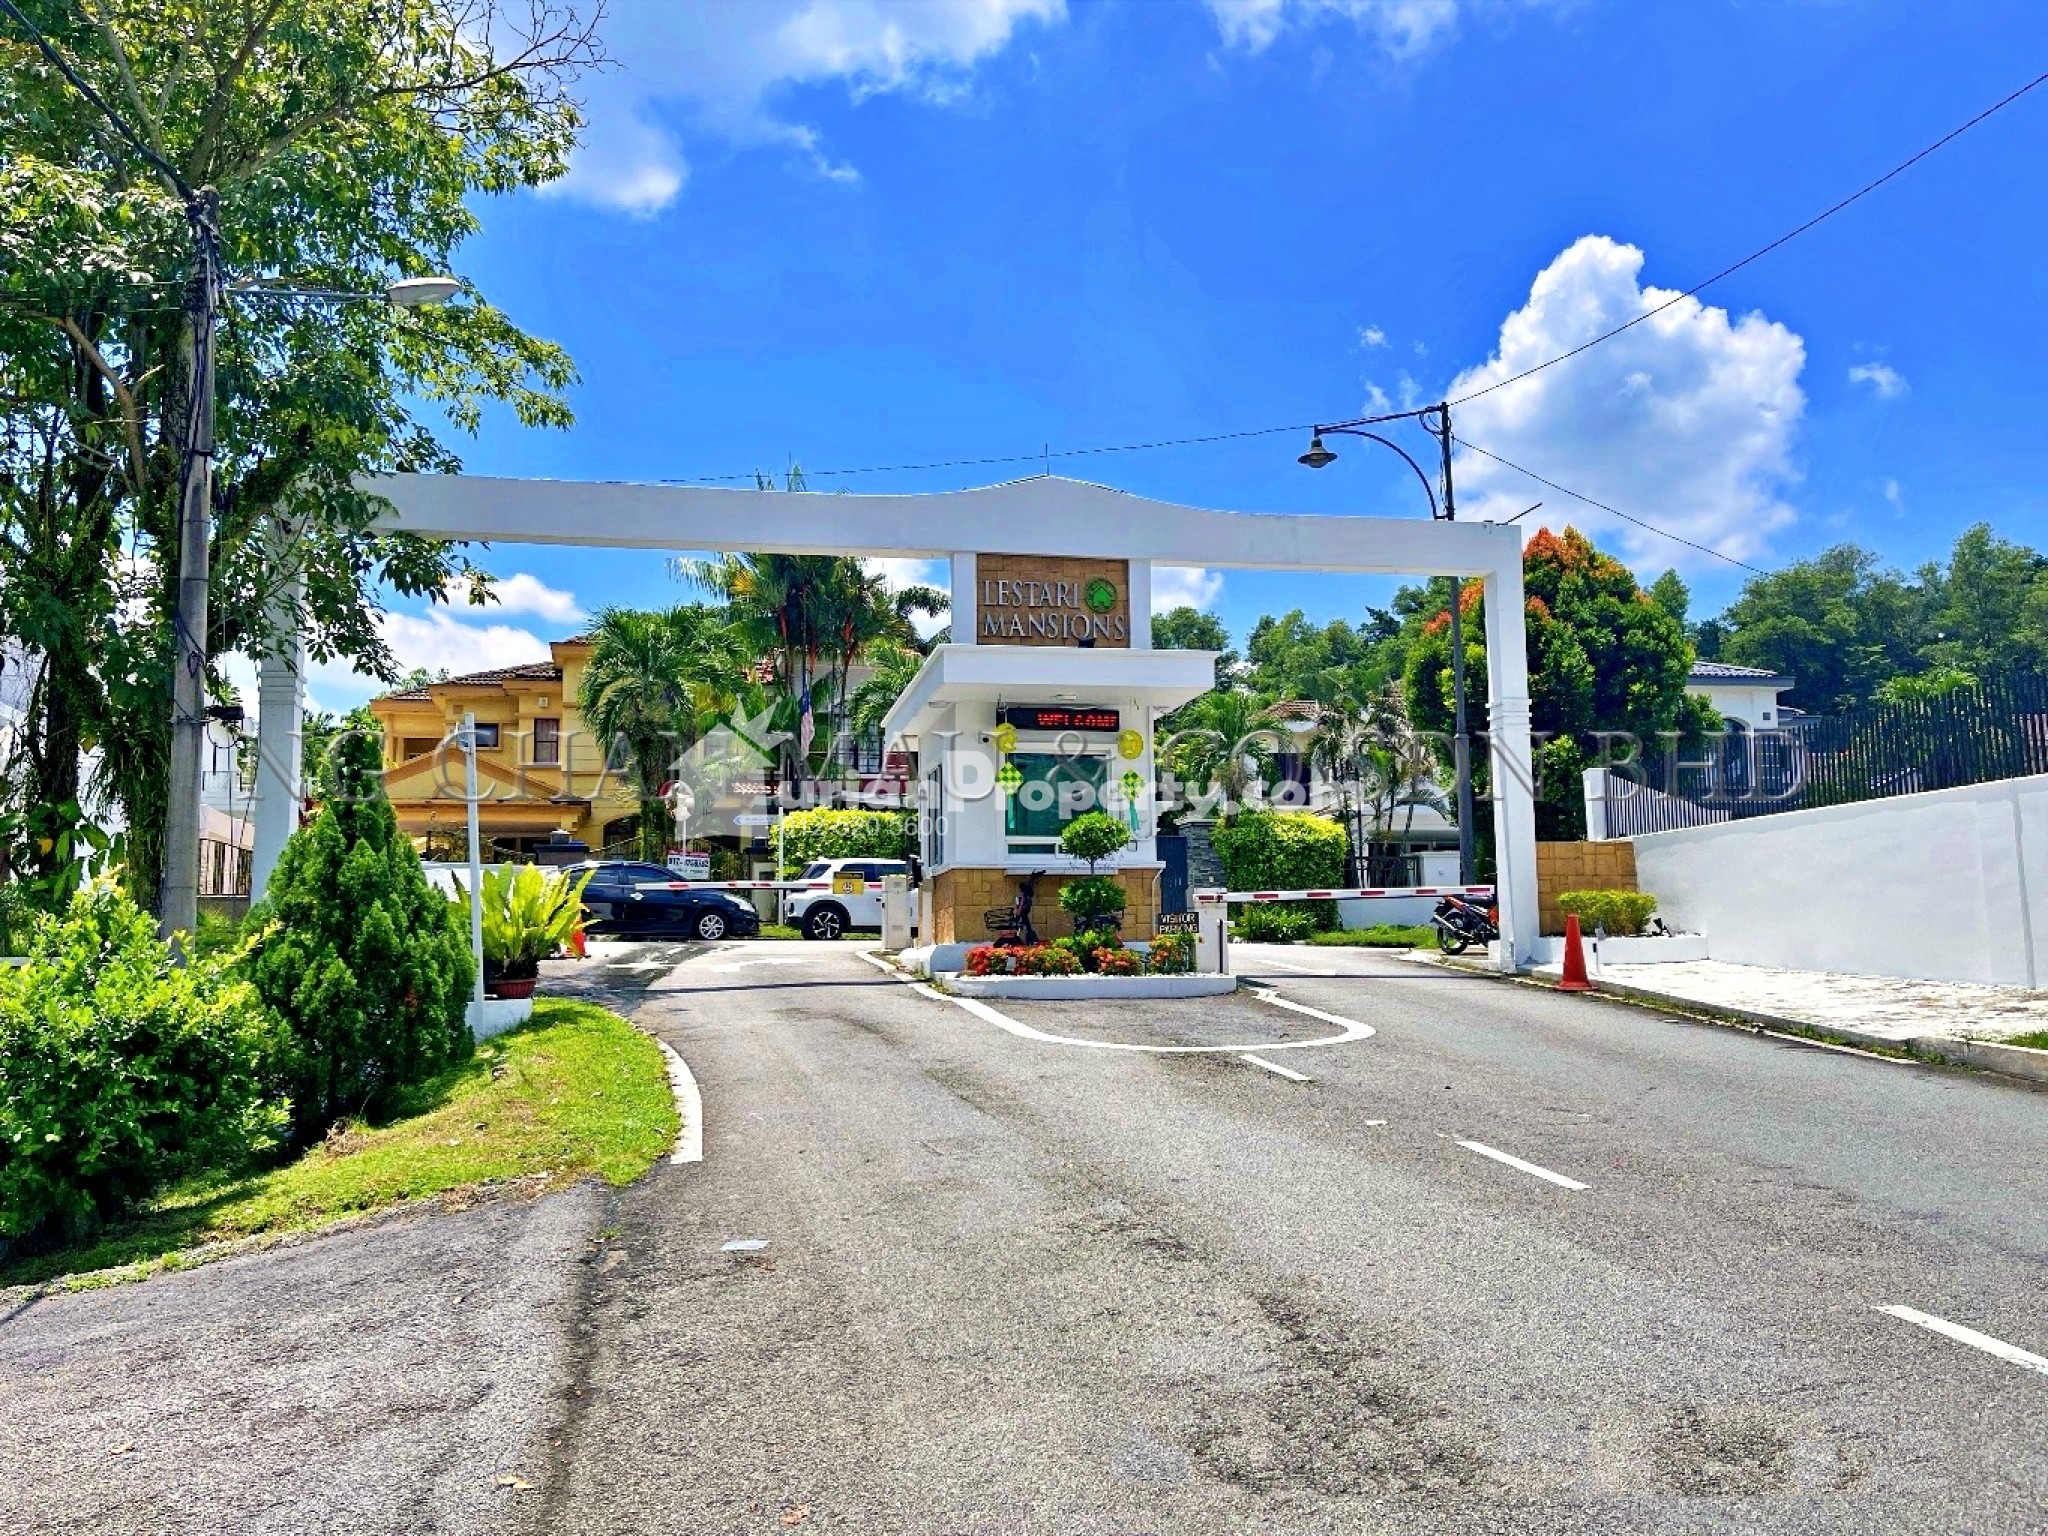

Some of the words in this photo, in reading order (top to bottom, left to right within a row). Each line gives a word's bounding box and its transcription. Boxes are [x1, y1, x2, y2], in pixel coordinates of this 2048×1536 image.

[984, 578, 1080, 608] LESTARI
[984, 611, 1126, 640] MANSIONS
[1160, 913, 1196, 924] VISITOR
